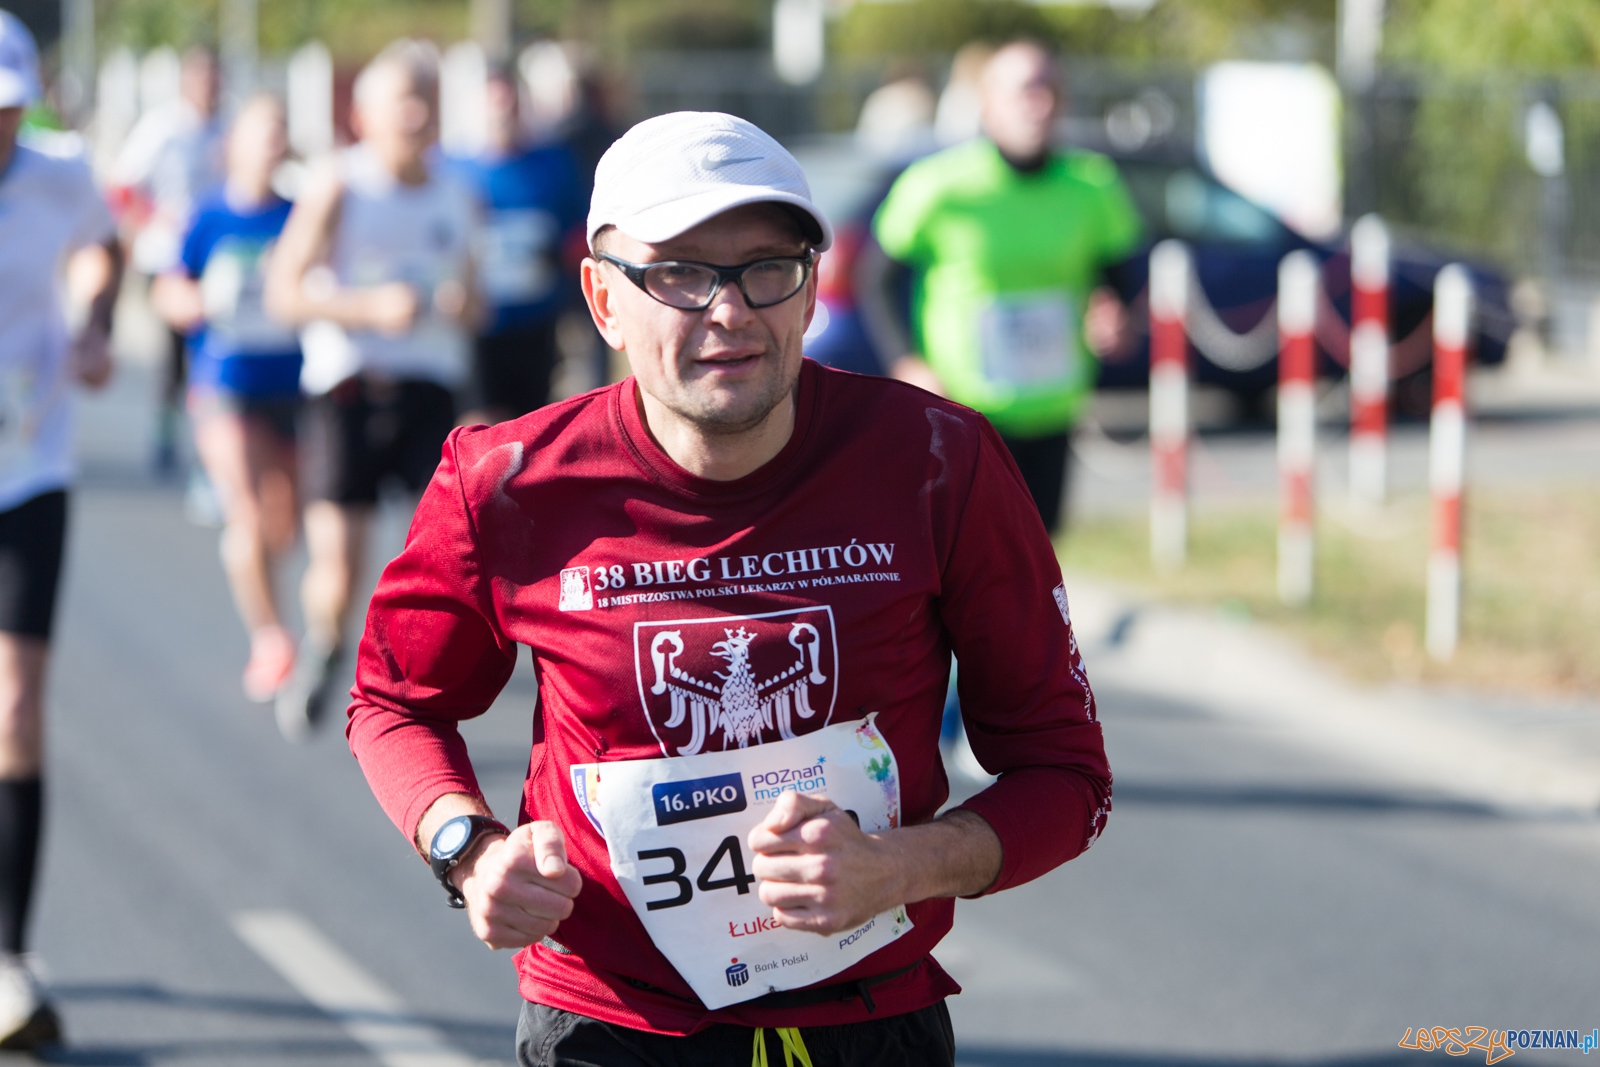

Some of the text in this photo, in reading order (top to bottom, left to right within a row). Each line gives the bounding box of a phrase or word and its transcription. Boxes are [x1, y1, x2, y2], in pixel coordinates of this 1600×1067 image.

[594, 538, 896, 591] 38 BIEG LECHITÓW
[597, 571, 901, 609] 18 MISTRZOSTWA POLSKI LEKARZY W PÓŁMARATONIE
[660, 793, 690, 813] 16.
[692, 785, 738, 808] PKO
[754, 776, 827, 801] maraton
[729, 915, 783, 938] Łuka
[754, 960, 779, 973] Bank
[782, 953, 809, 968] Polski
